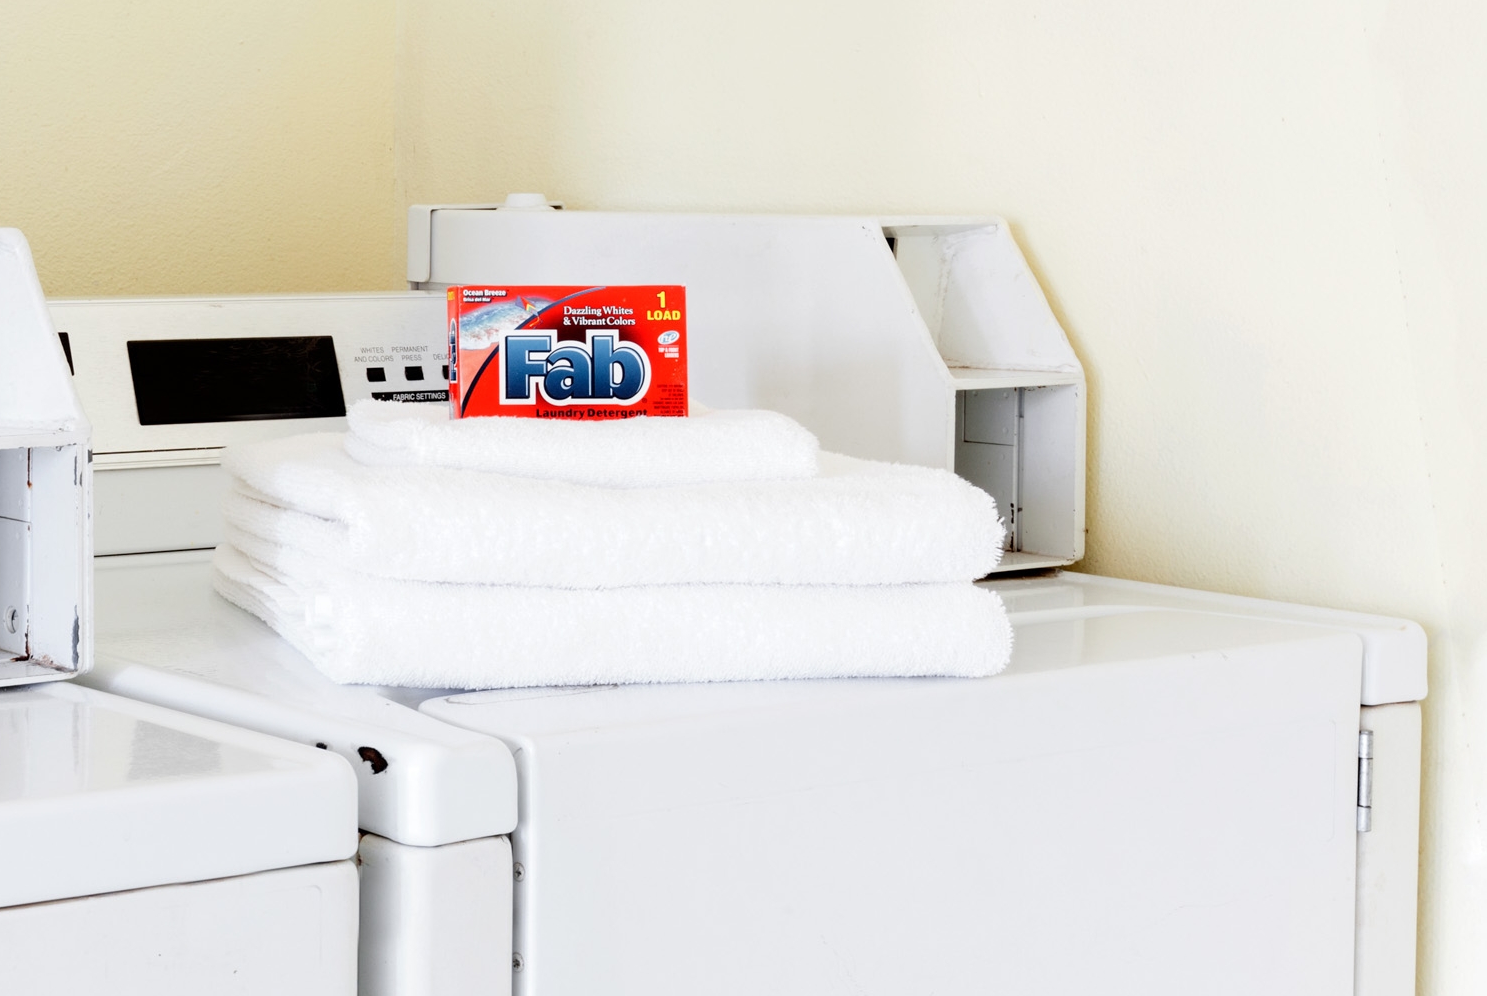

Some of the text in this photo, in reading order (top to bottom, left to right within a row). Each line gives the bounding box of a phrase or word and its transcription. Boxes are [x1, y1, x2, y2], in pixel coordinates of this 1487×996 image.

[656, 291, 666, 308] 1
[563, 306, 633, 316] Dazzling Whites
[647, 310, 681, 320] LOAD
[563, 316, 636, 326] & Vibrant Colors
[503, 333, 647, 402] Fab
[393, 392, 446, 401] FABRIC SETTINGS
[536, 408, 647, 420] Laundry Detergent
